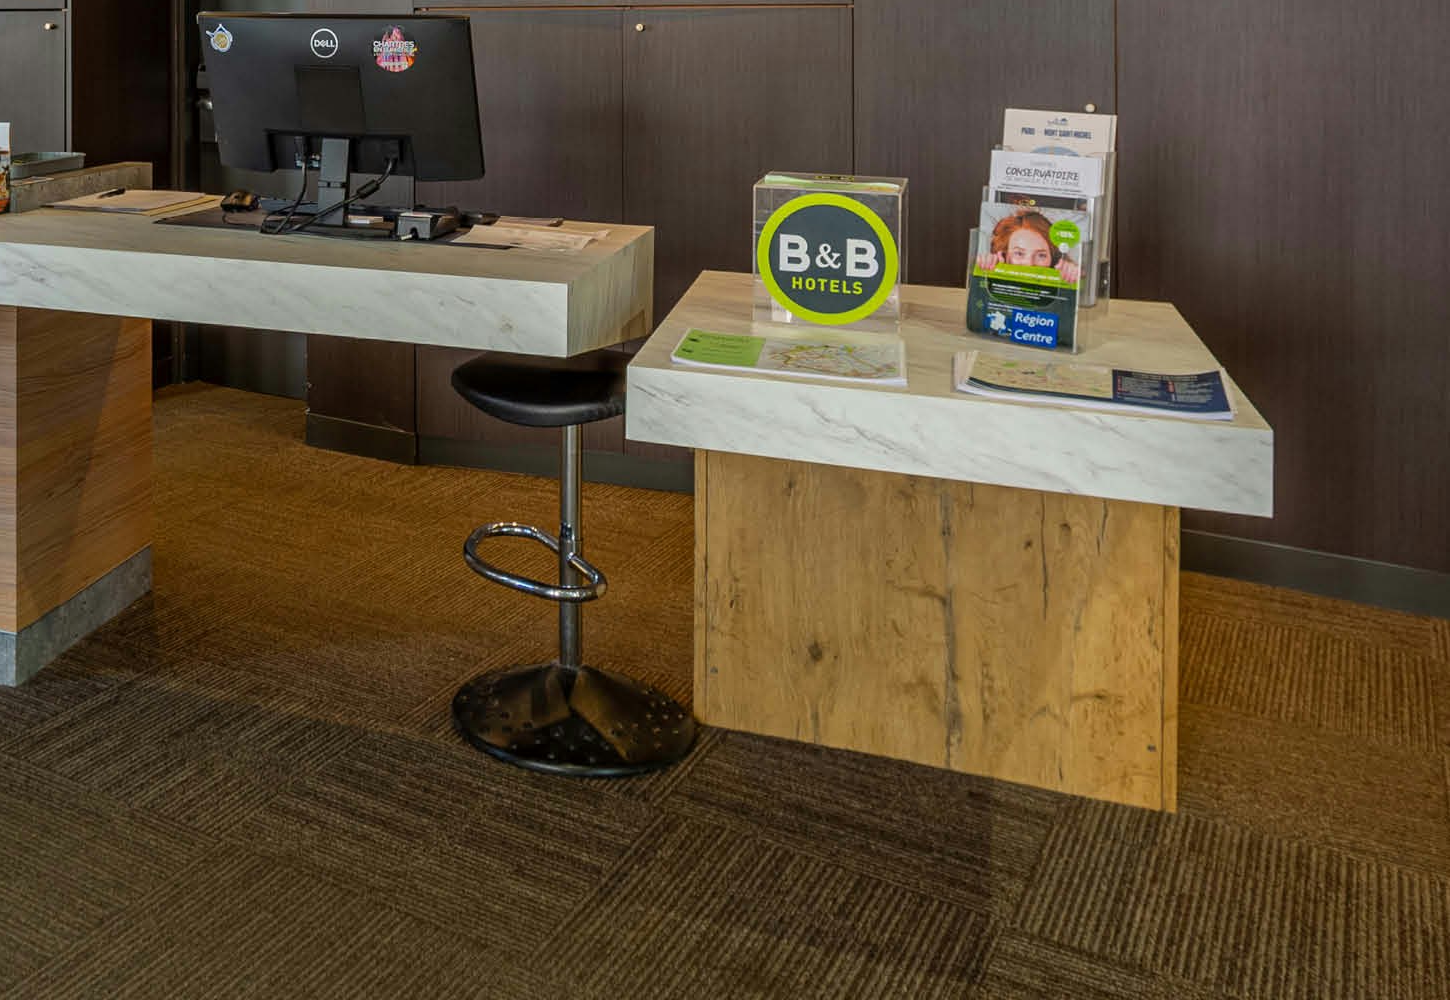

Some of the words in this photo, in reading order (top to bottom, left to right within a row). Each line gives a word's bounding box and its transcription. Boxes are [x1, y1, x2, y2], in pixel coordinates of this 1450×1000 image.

[314, 39, 335, 48] DELL
[1005, 166, 1079, 181] CONSERVATOIRE
[790, 276, 864, 295] HOTELS
[1014, 312, 1055, 328] Région
[1014, 329, 1054, 345] Centre
